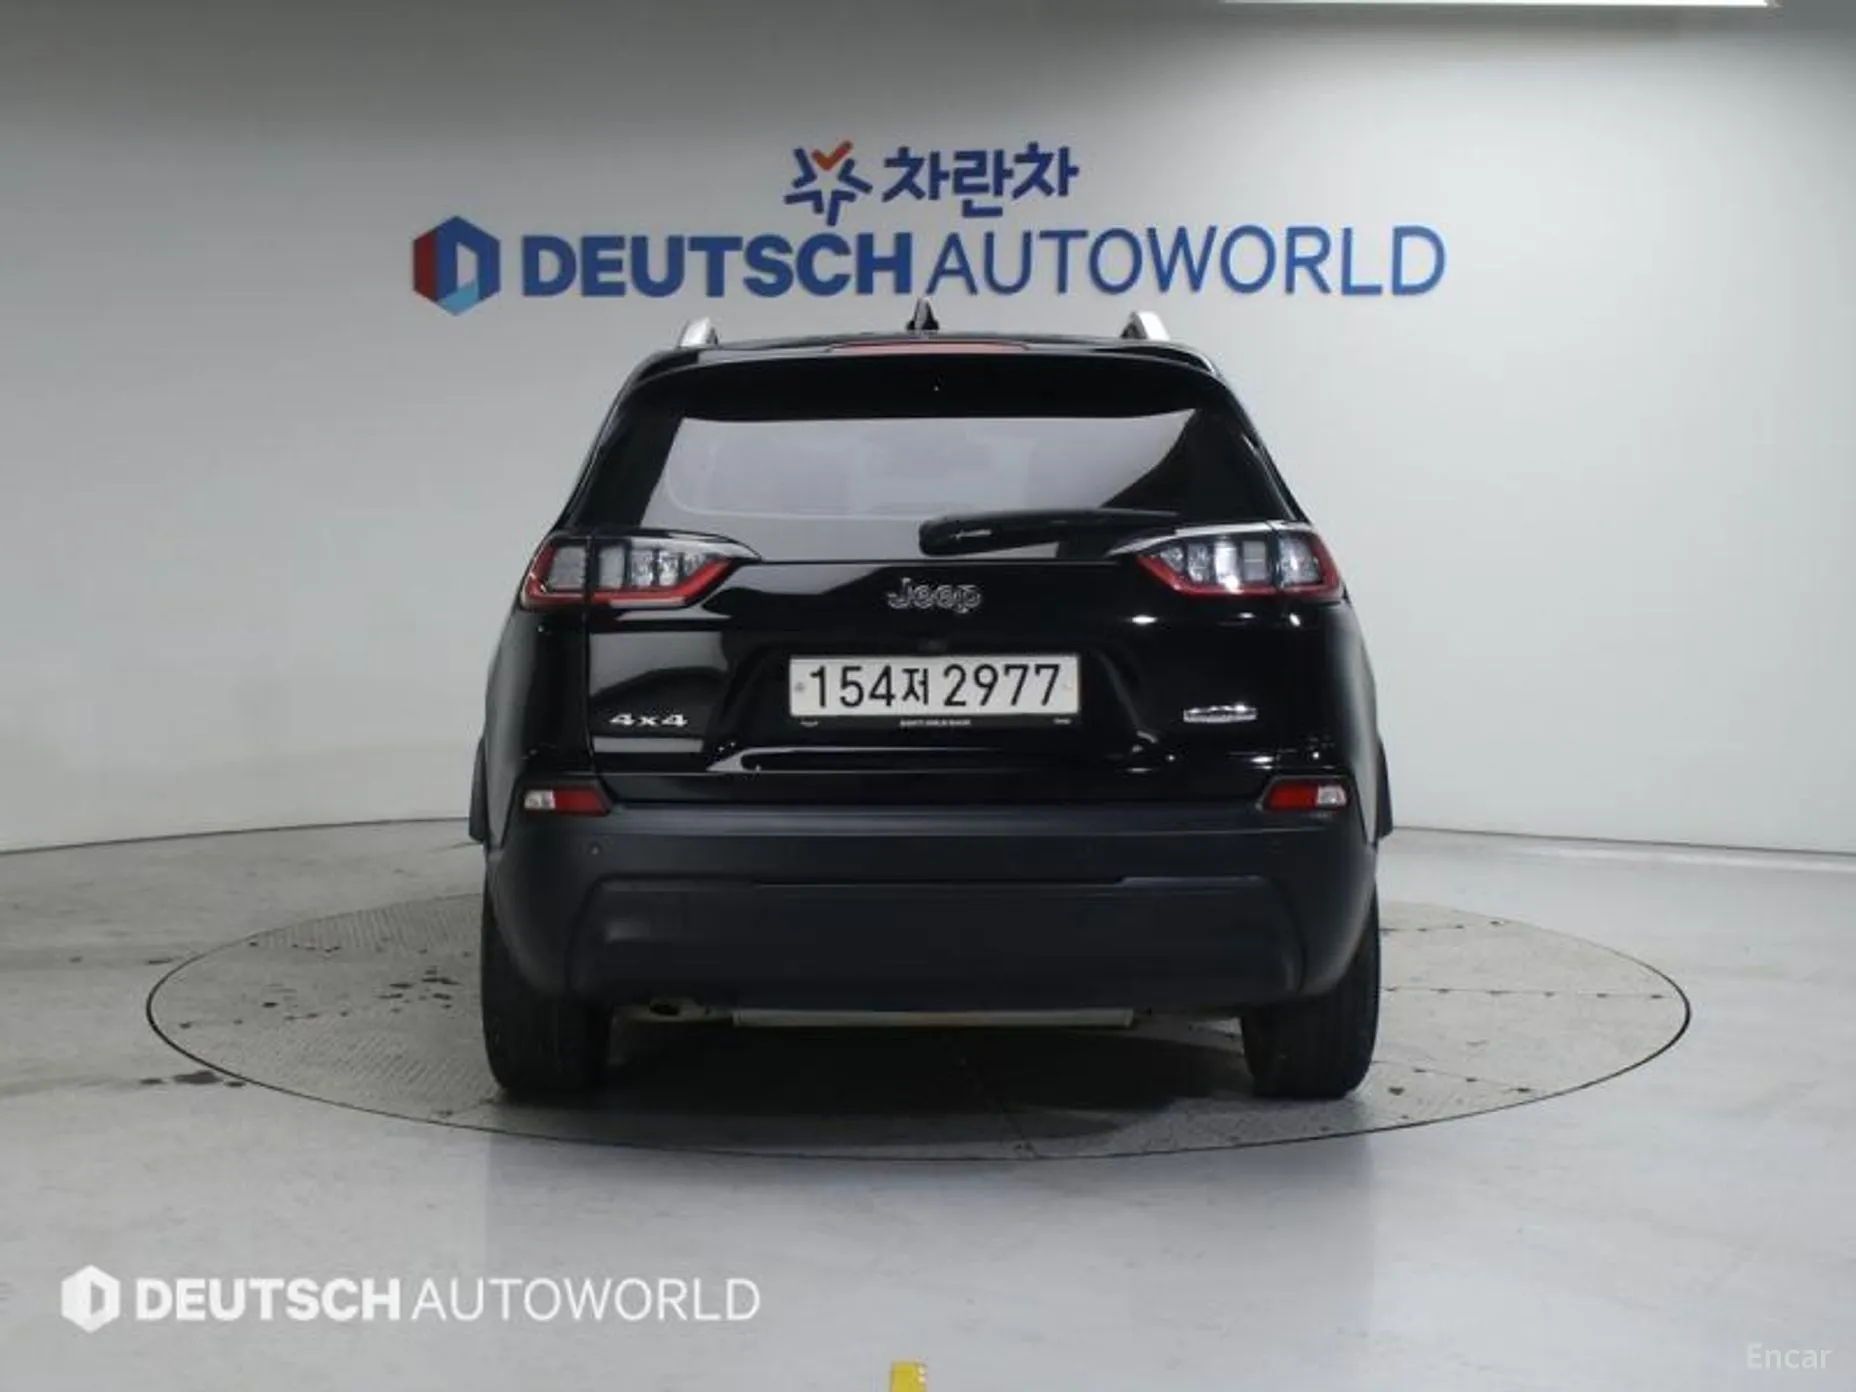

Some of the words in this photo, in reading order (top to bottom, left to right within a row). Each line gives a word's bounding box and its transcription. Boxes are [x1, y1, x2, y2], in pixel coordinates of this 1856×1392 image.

[882, 142, 1079, 218] 차란차
[521, 233, 913, 298] DEUTSCH
[926, 225, 1447, 295] AUTOWORLD
[887, 577, 981, 613] Jeep
[809, 664, 929, 708] 154저
[942, 663, 1060, 707] 2977
[609, 713, 688, 727] 4x4
